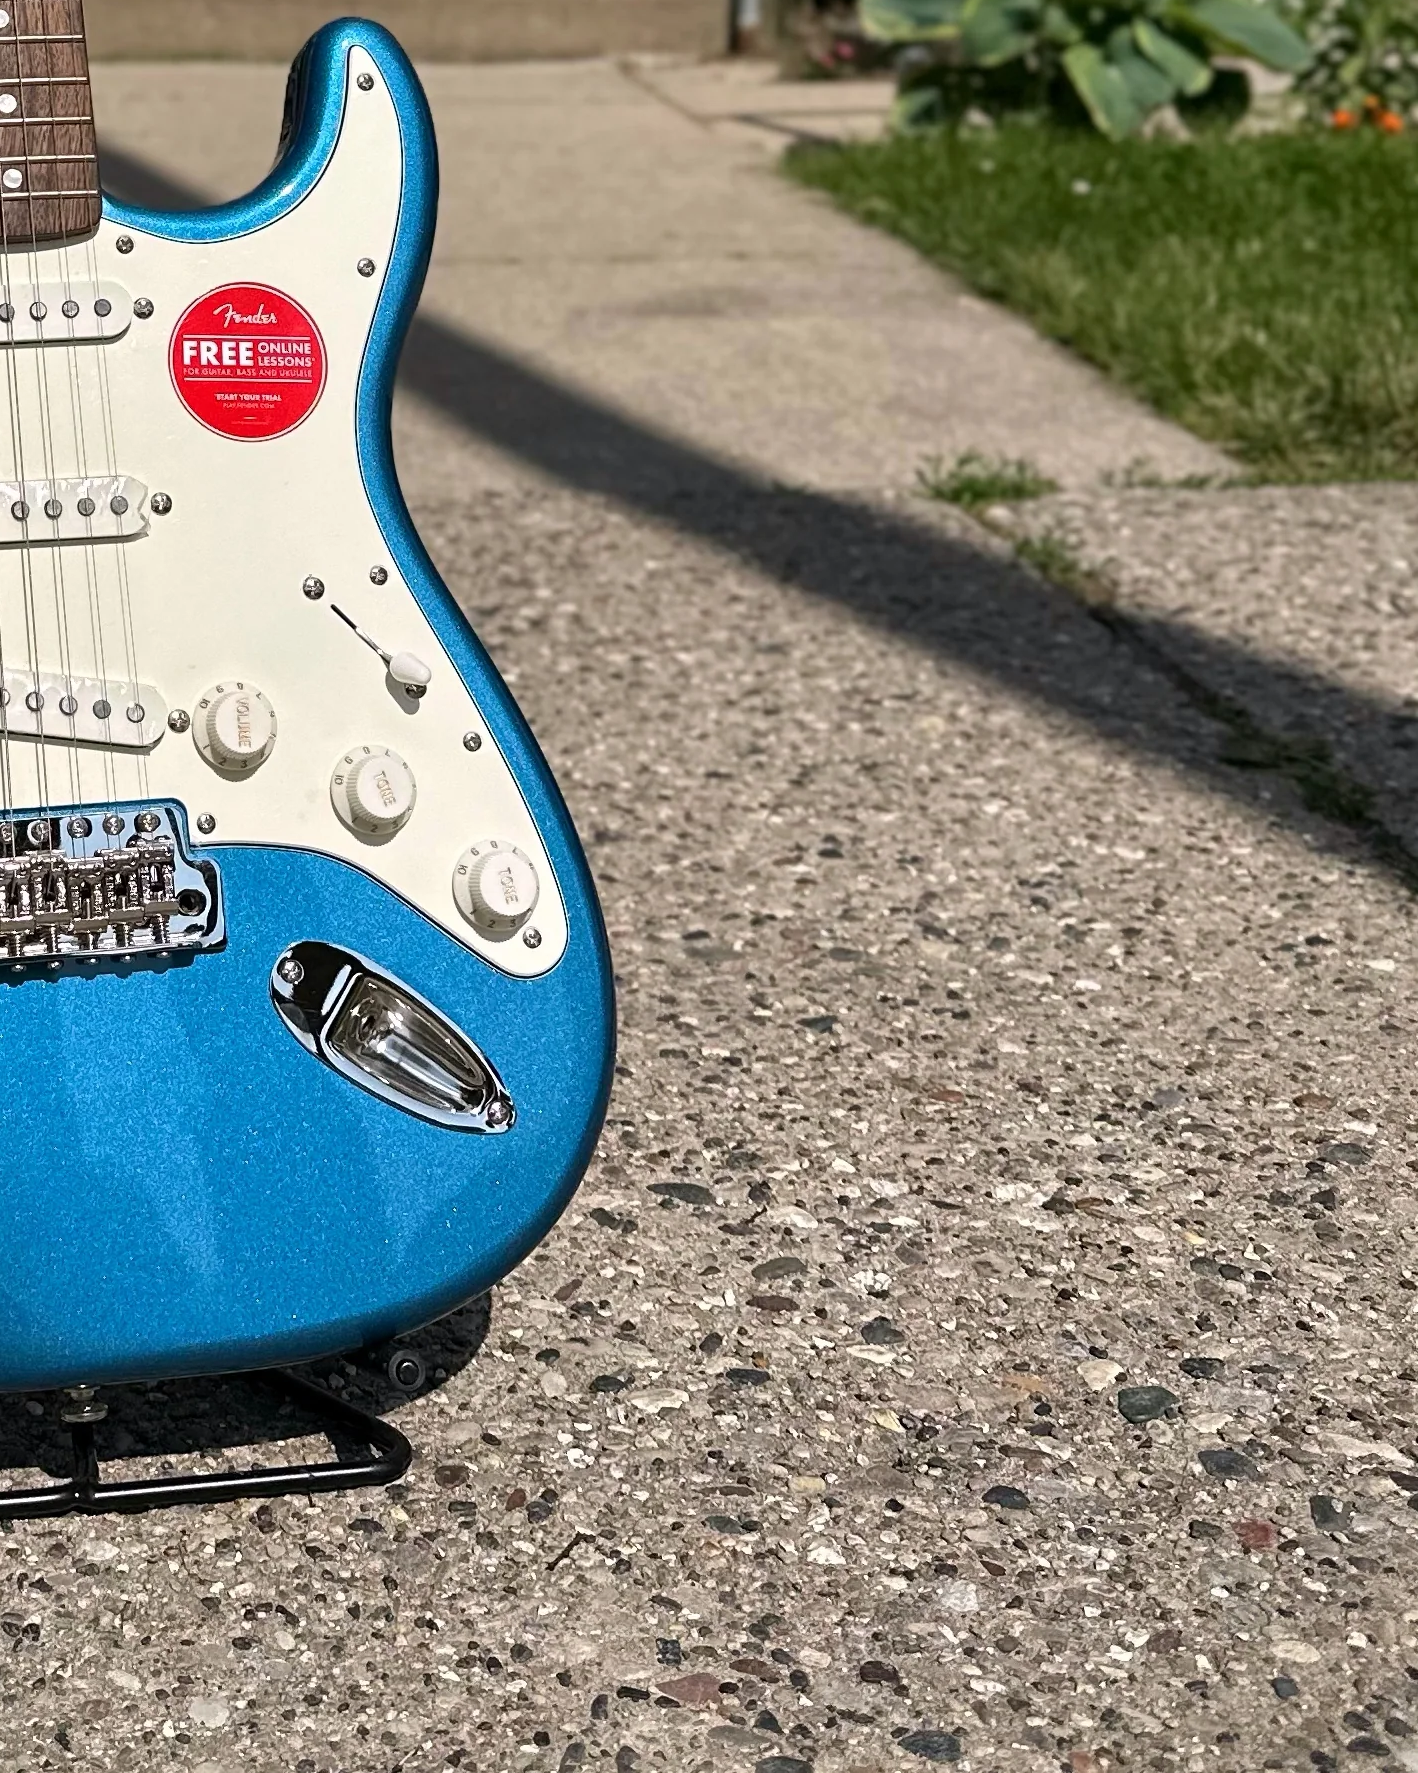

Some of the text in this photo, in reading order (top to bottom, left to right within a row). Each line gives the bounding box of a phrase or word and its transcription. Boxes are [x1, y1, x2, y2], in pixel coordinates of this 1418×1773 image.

[213, 303, 278, 328] Fender
[182, 340, 312, 366] FREE ONLINE
[257, 356, 313, 367] LESSONS
[183, 368, 199, 376] FOR
[236, 369, 256, 377] BASS
[258, 369, 278, 377] AND
[237, 697, 251, 748] VOLUME
[219, 756, 227, 766] 2
[374, 770, 397, 807] TONE
[370, 824, 378, 833] 2
[498, 866, 519, 905] TONE
[487, 919, 496, 928] 2
